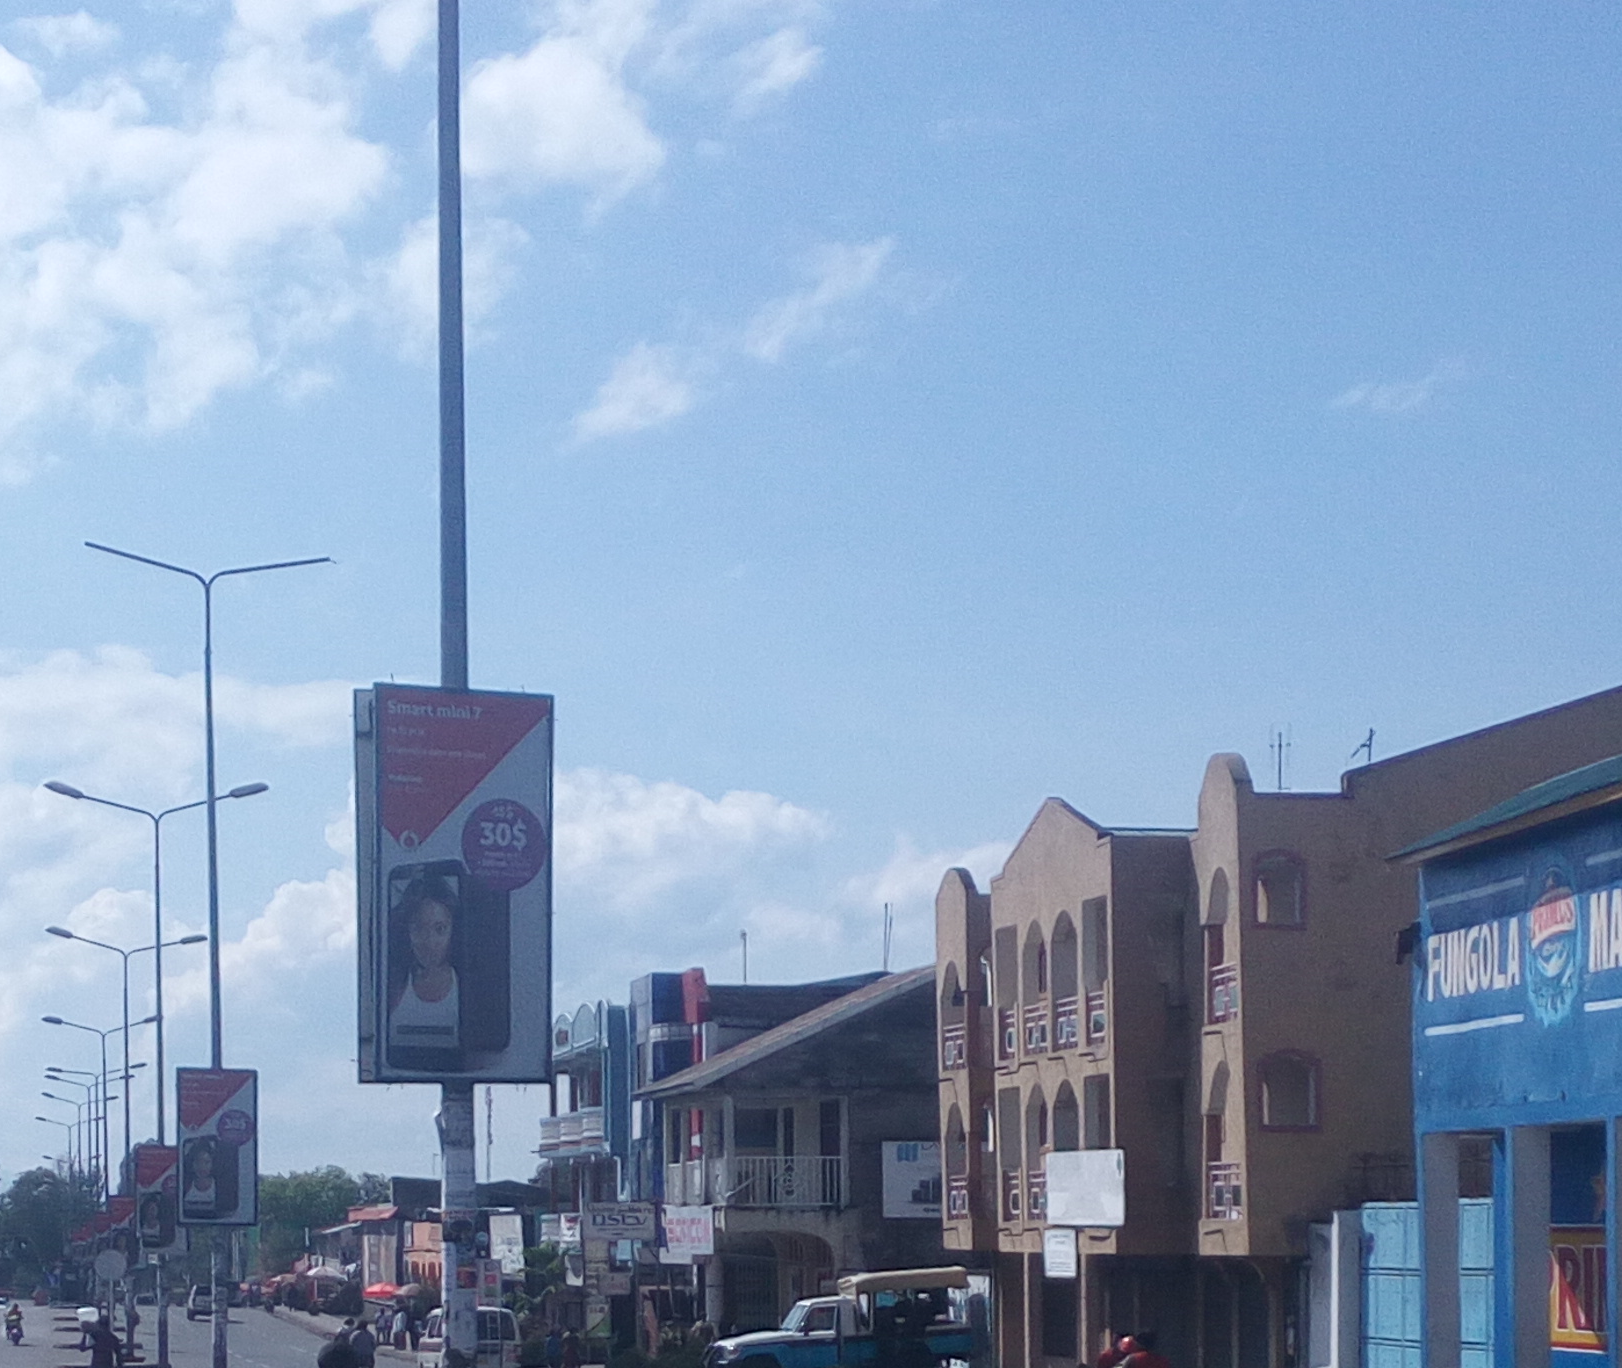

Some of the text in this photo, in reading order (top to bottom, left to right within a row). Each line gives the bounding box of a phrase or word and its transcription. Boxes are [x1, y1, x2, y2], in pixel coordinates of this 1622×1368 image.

[387, 700, 434, 717] Smart
[436, 704, 471, 719] mini
[479, 818, 528, 851] 30$
[1427, 917, 1521, 1002] FUNGOLA
